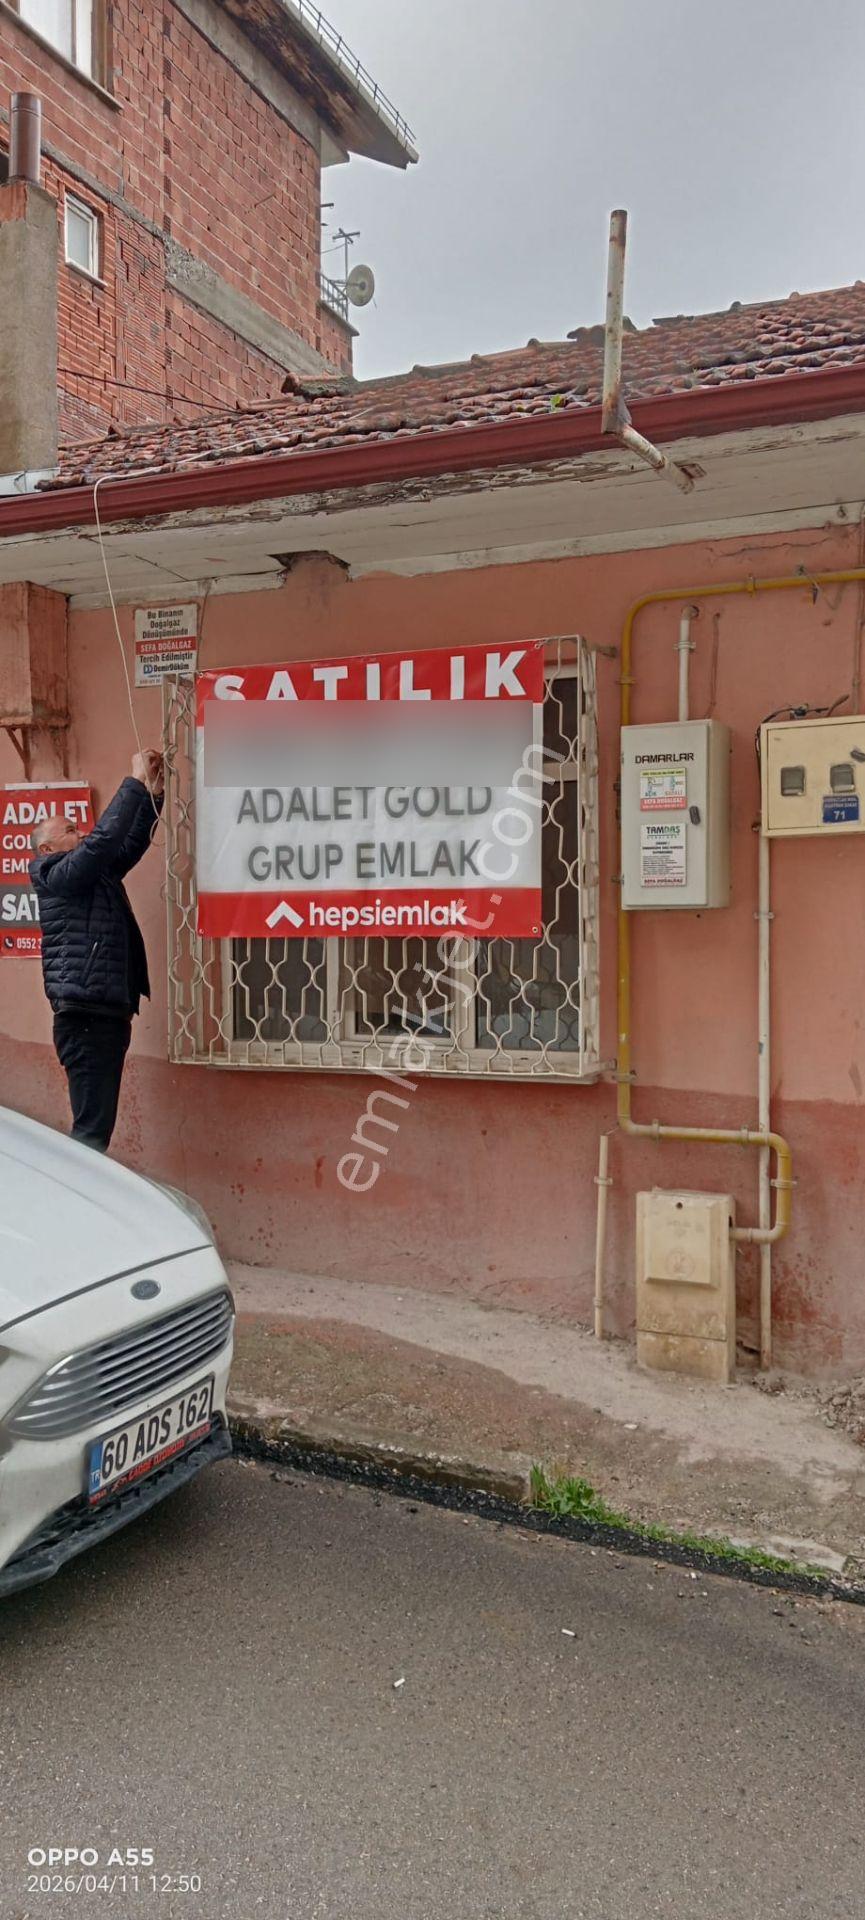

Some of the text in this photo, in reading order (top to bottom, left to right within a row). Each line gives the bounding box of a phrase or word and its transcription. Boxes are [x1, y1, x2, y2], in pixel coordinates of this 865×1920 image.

[147, 611, 156, 619] Bu
[140, 653, 160, 663] Tercih
[214, 651, 527, 700] SATILIK
[635, 753, 694, 764] DAMARLAR
[237, 787, 492, 824] ADALET GOLD
[833, 810, 846, 820] 71
[248, 839, 482, 881] GRUP EMLAK
[309, 899, 467, 931] hepsiemlak
[16, 937, 37, 949] 0552
[102, 1433, 128, 1479] 60
[133, 1408, 172, 1461] ADS
[177, 1387, 209, 1434] 162
